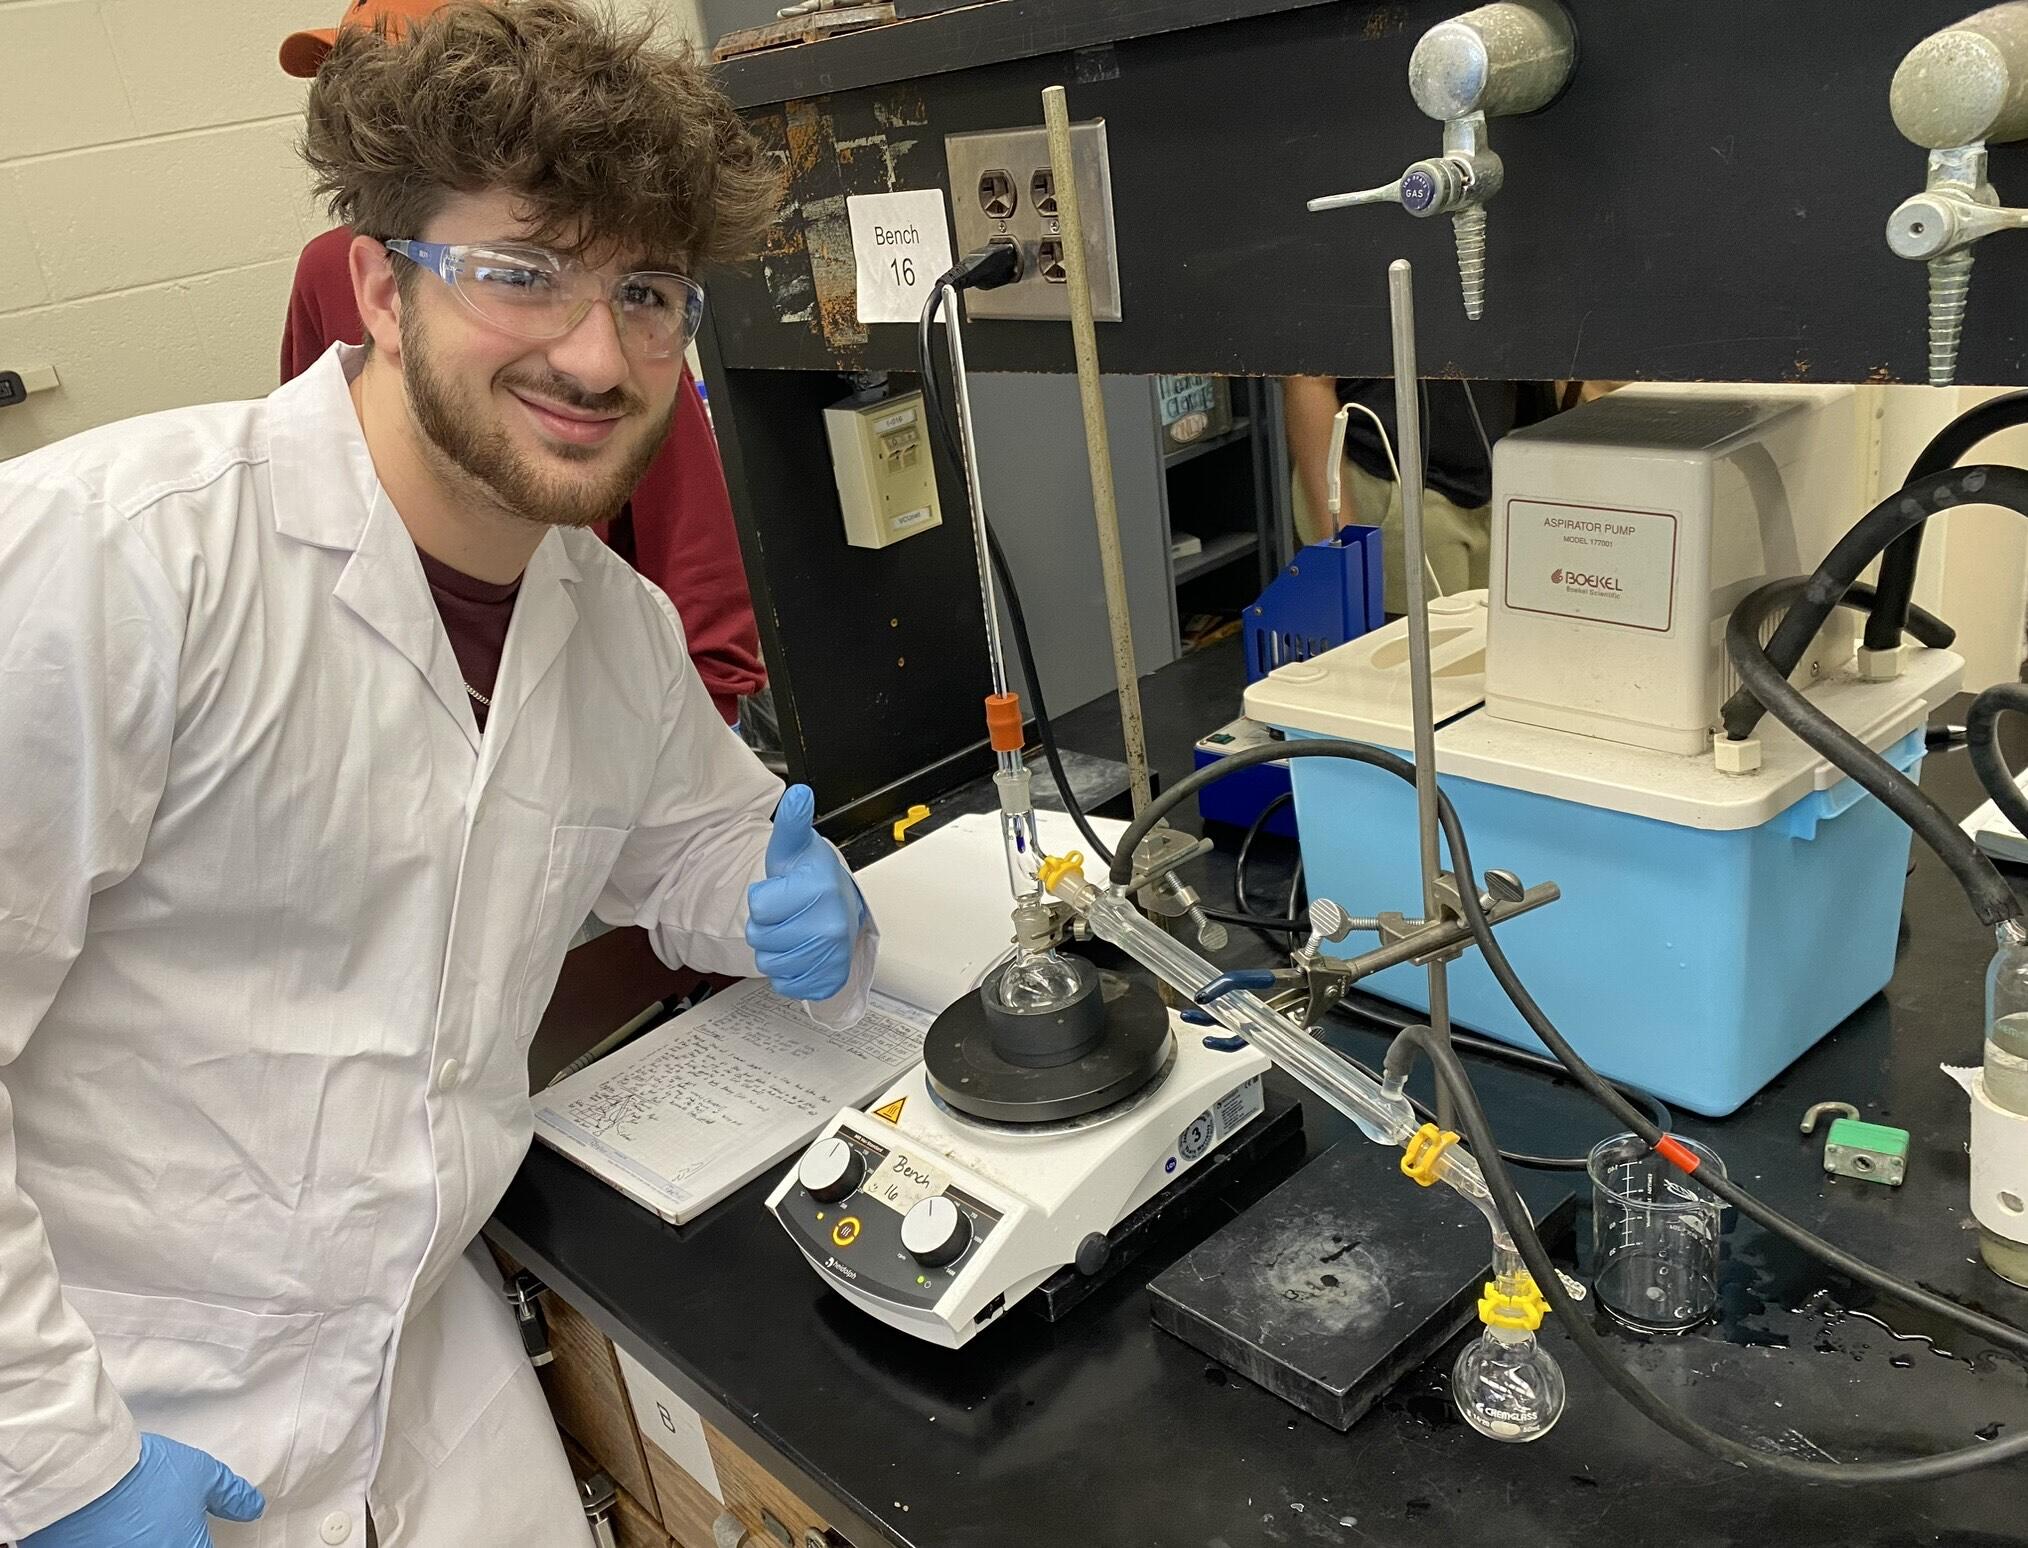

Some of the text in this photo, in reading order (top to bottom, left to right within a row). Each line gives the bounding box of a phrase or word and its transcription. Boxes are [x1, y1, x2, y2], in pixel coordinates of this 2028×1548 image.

[1405, 189, 1424, 198] GAS
[874, 224, 920, 246] Bench
[890, 257, 916, 287] 16
[1543, 517, 1636, 537] ASPIRATOR PUMP
[1563, 535, 1588, 545] MODEL
[1565, 571, 1623, 592] BOEKEL
[1589, 589, 1621, 600] Scientific
[1191, 1126, 1202, 1143] 3
[892, 1154, 930, 1189] Bench
[884, 1183, 898, 1201] 16
[832, 1260, 857, 1280] heidolph
[656, 1401, 676, 1434] B
[1485, 1407, 1538, 1421] CHEMGLASS
